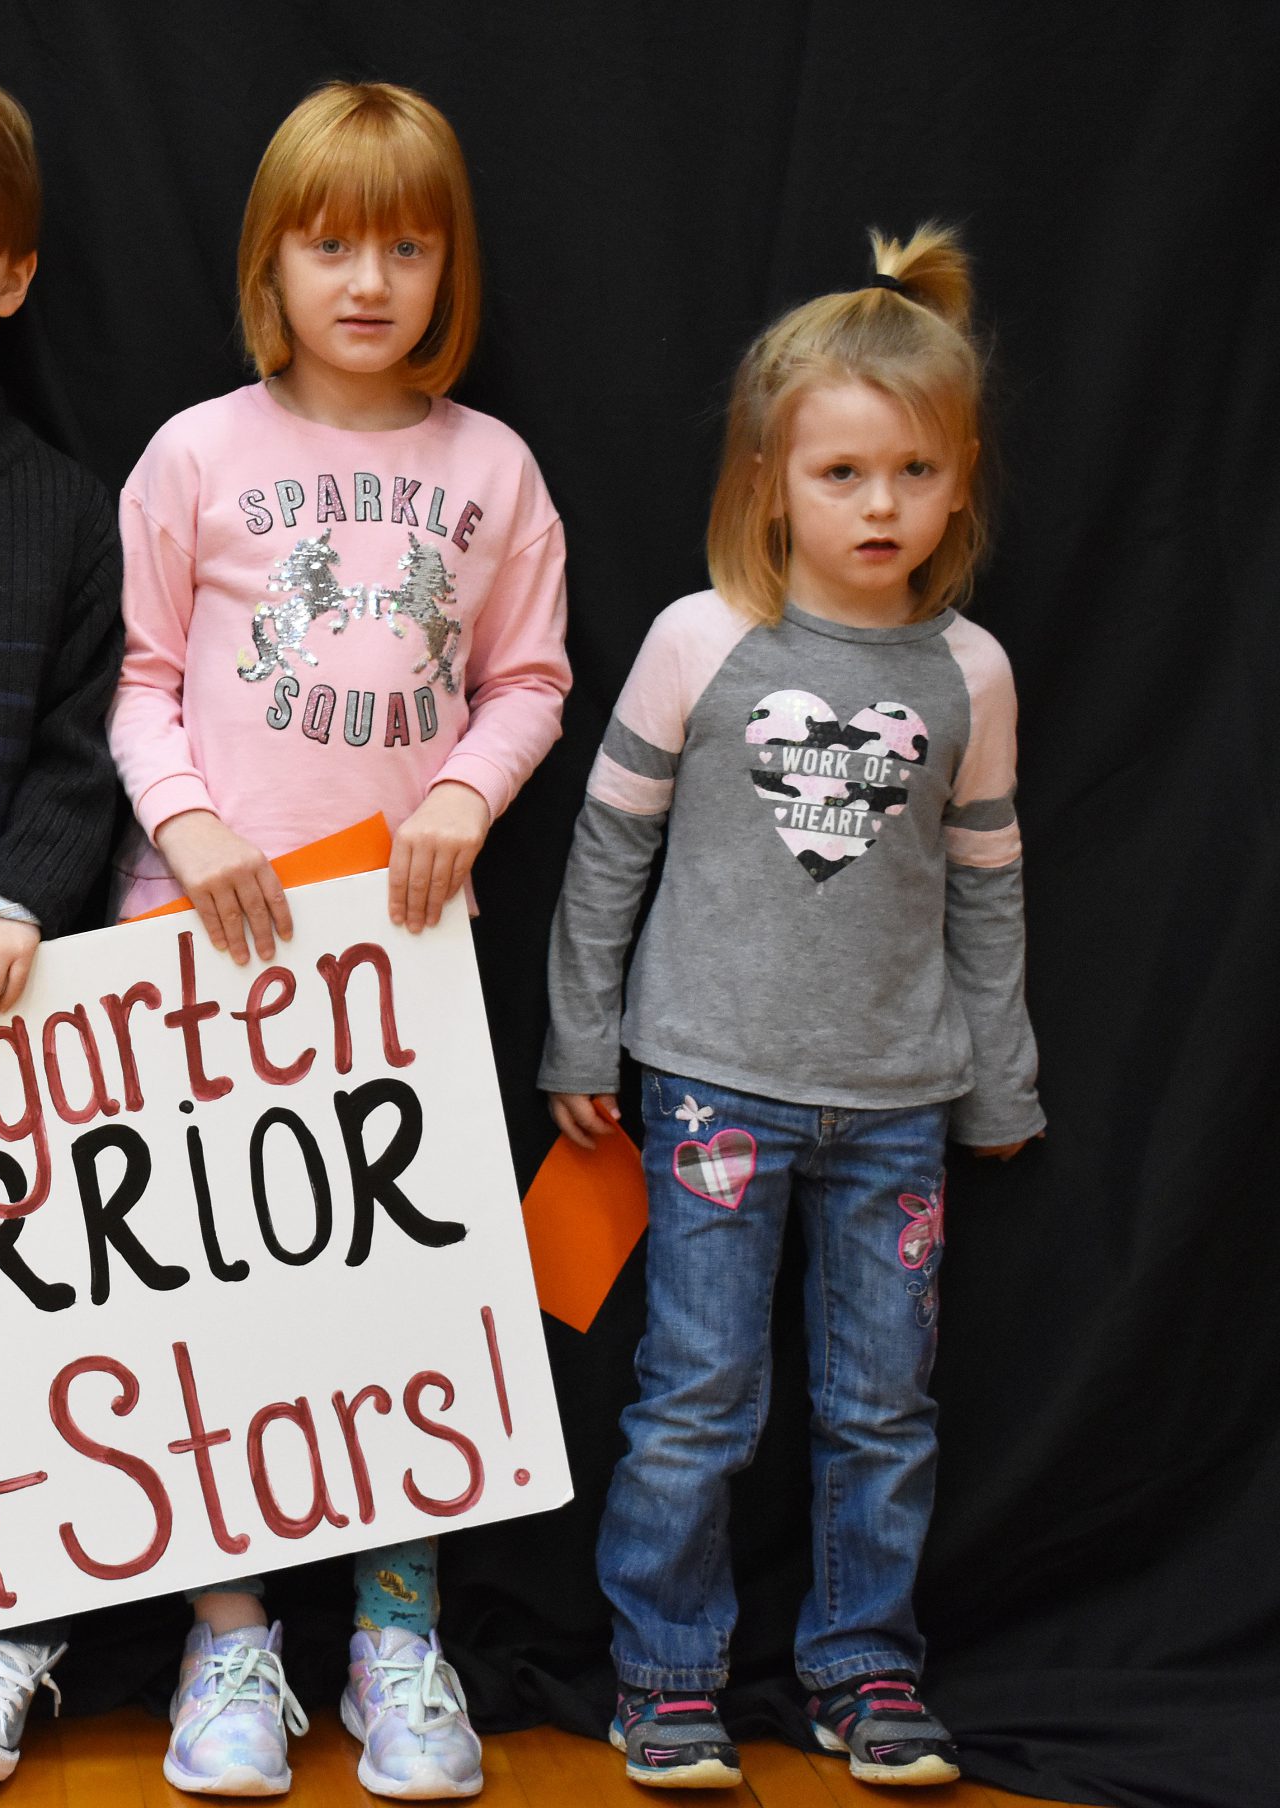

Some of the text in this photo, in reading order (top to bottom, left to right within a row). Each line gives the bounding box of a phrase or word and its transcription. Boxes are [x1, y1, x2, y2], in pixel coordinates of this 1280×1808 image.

[238, 472, 484, 552] SPARKLE
[266, 676, 439, 747] SQUAD
[782, 746, 893, 783] WORK OF
[790, 804, 867, 836] HEART
